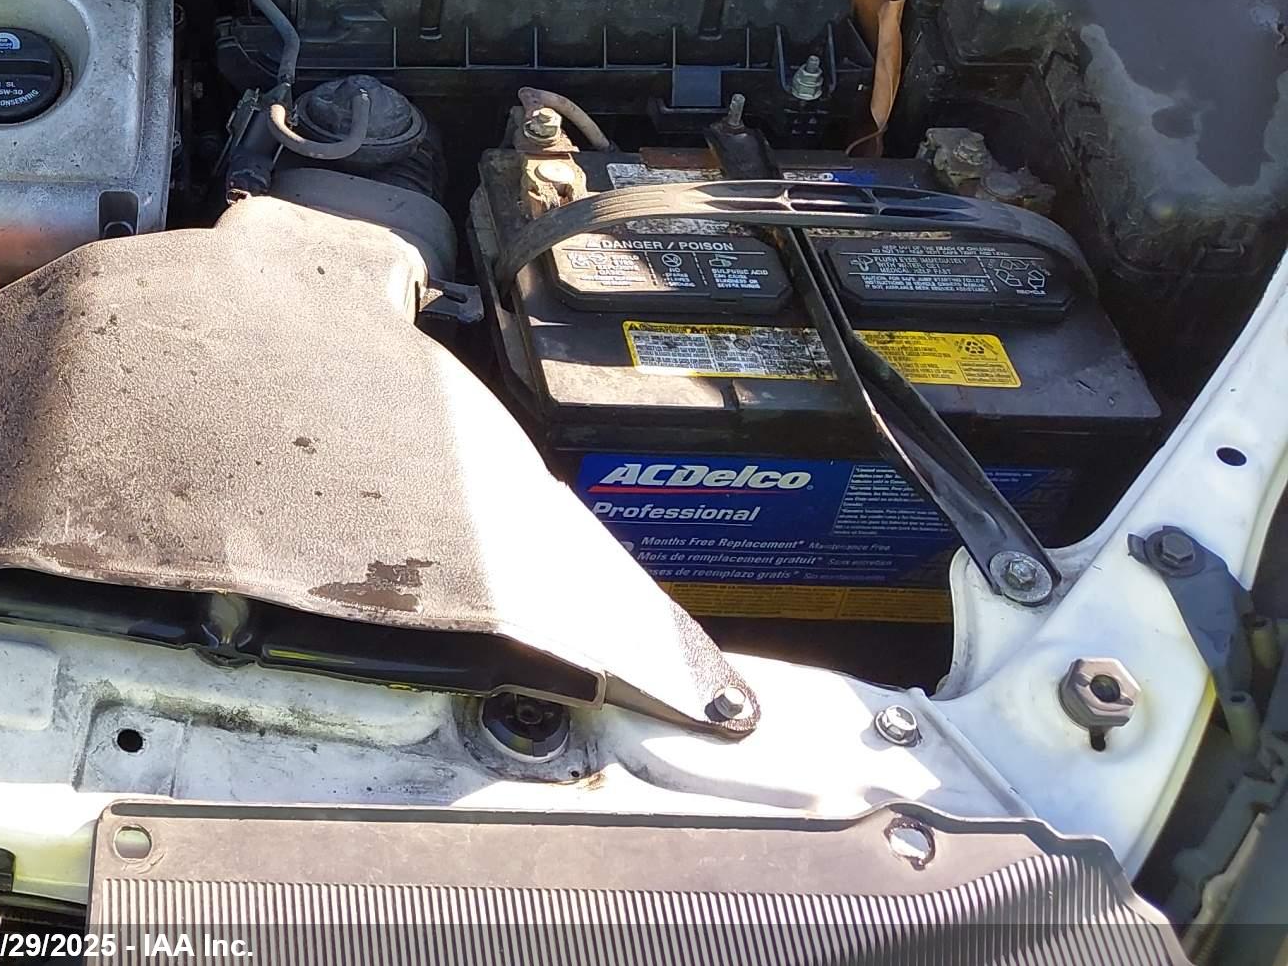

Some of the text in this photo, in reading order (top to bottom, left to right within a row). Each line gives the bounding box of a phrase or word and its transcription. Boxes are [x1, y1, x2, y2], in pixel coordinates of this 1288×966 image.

[601, 240, 734, 251] DANGER / POISON
[600, 463, 812, 489] ACDelco
[592, 502, 761, 521] Professional
[640, 536, 687, 546] Months
[688, 537, 716, 547] Free
[637, 551, 668, 561] Mois
[669, 551, 686, 561] de
[687, 552, 773, 564] remplacement
[675, 567, 691, 576] de
[692, 569, 755, 578] reemplazo
